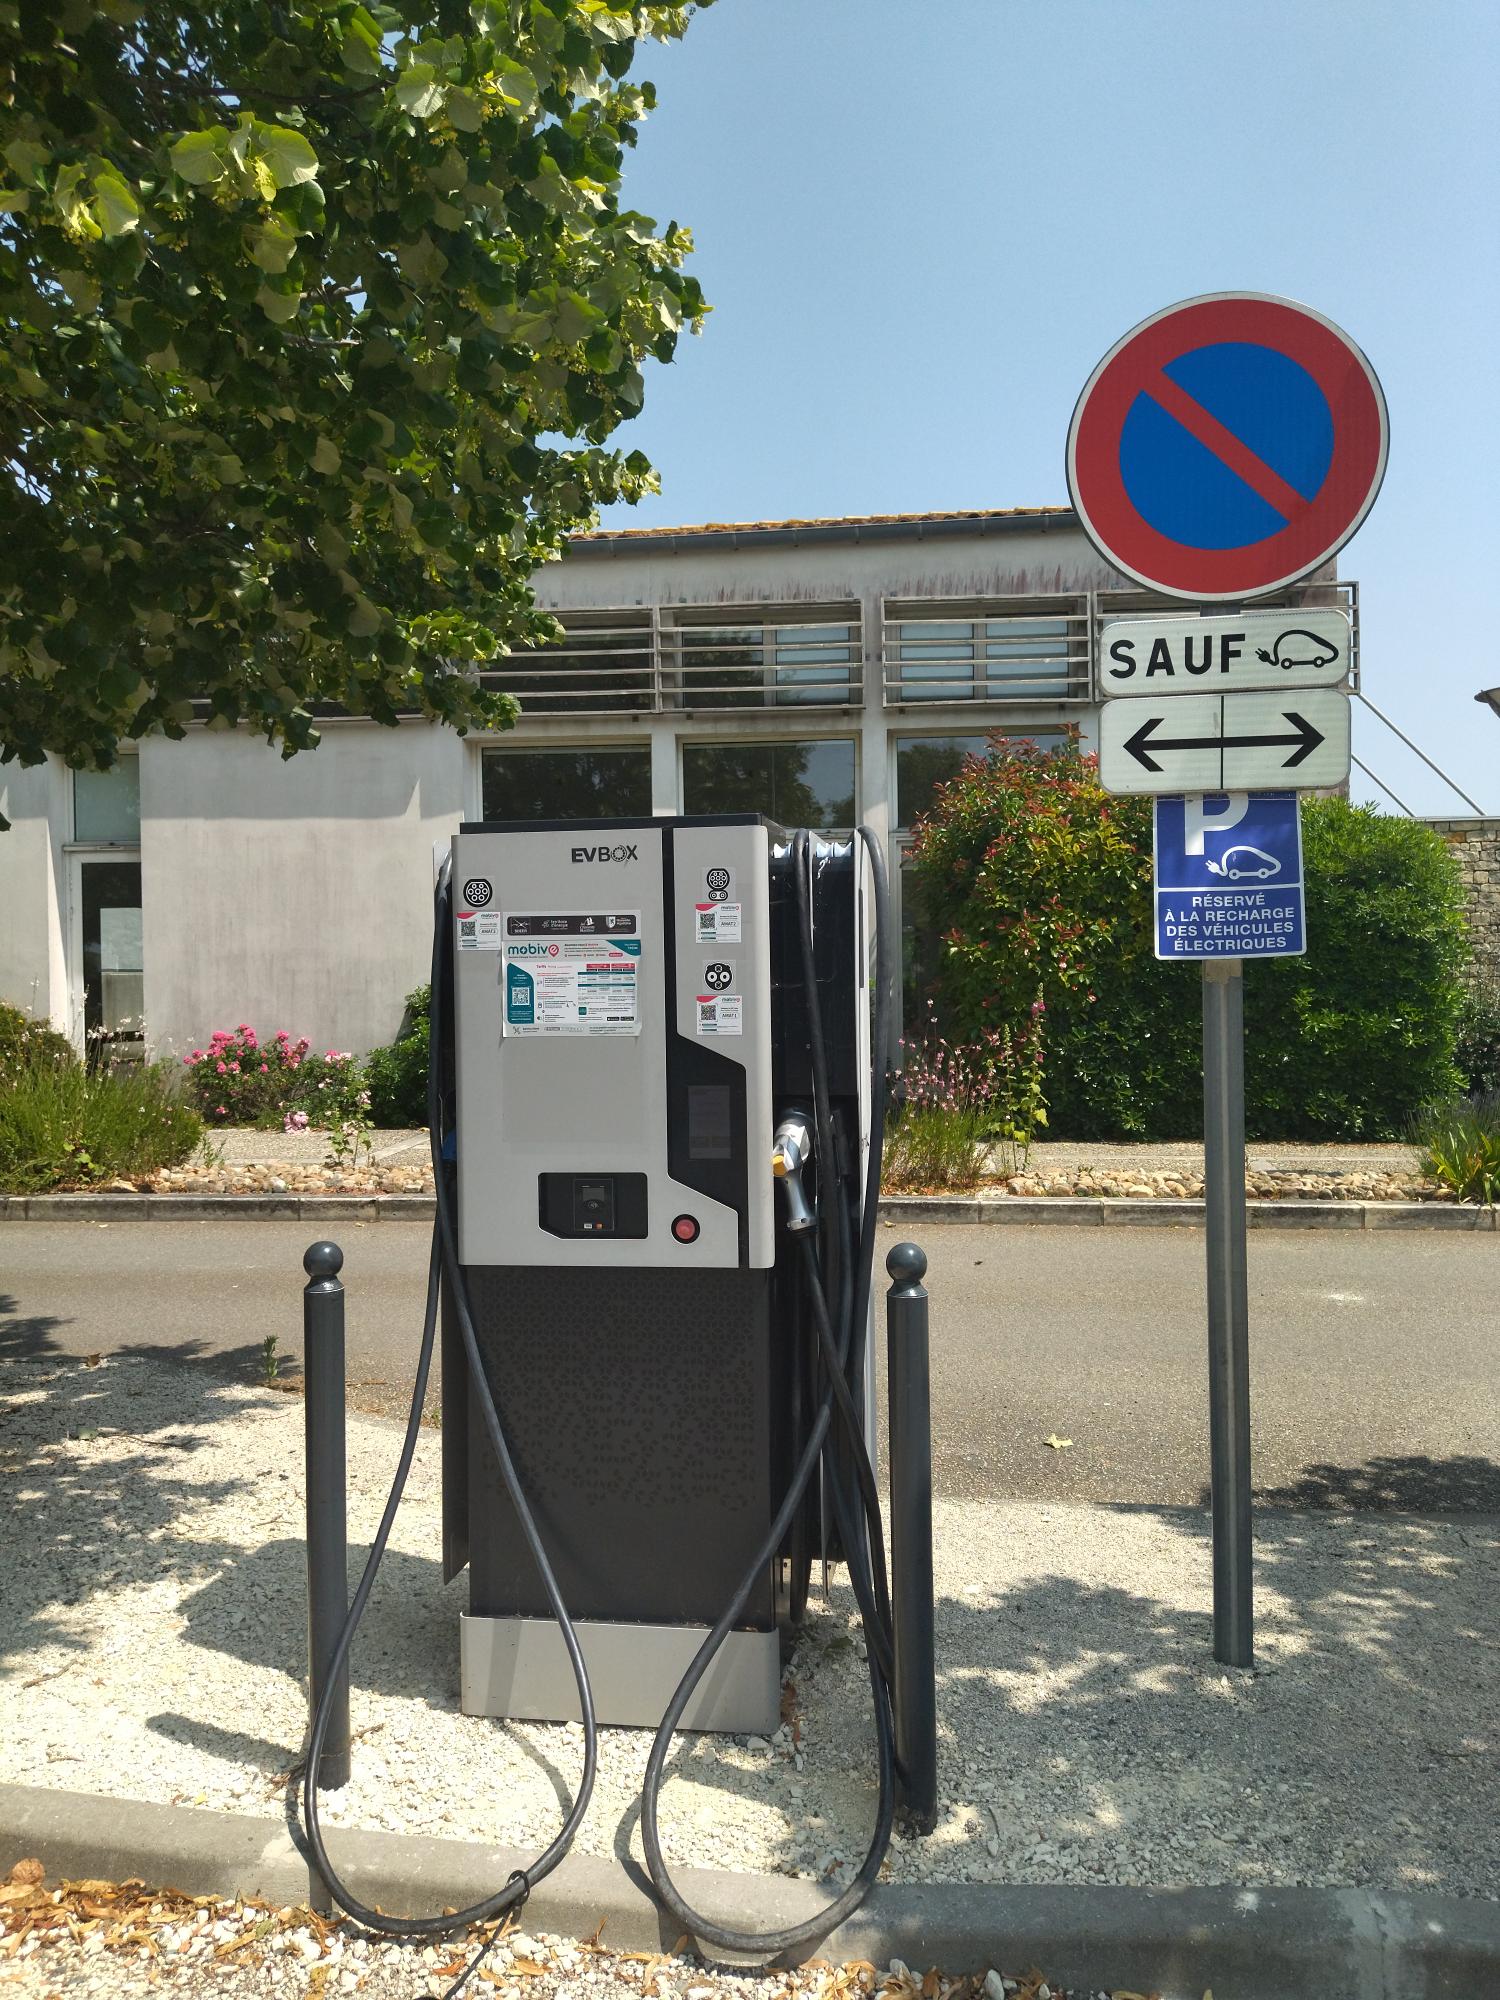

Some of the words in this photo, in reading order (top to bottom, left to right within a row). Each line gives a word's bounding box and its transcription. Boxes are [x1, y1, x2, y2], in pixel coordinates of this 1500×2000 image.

[1109, 633, 1246, 679] SAUF
[1184, 791, 1249, 855] P
[571, 845, 638, 863] EVBOX
[1192, 892, 1265, 907] RÉSERVÉ
[1165, 909, 1175, 922] À
[1180, 911, 1200, 922] LA
[1205, 907, 1295, 922] RECHARGE
[1166, 925, 1198, 937] DES
[1202, 922, 1294, 936] VÉHICULES
[508, 943, 559, 957] mobive
[1174, 937, 1287, 951] ÉLECTRIQUES
